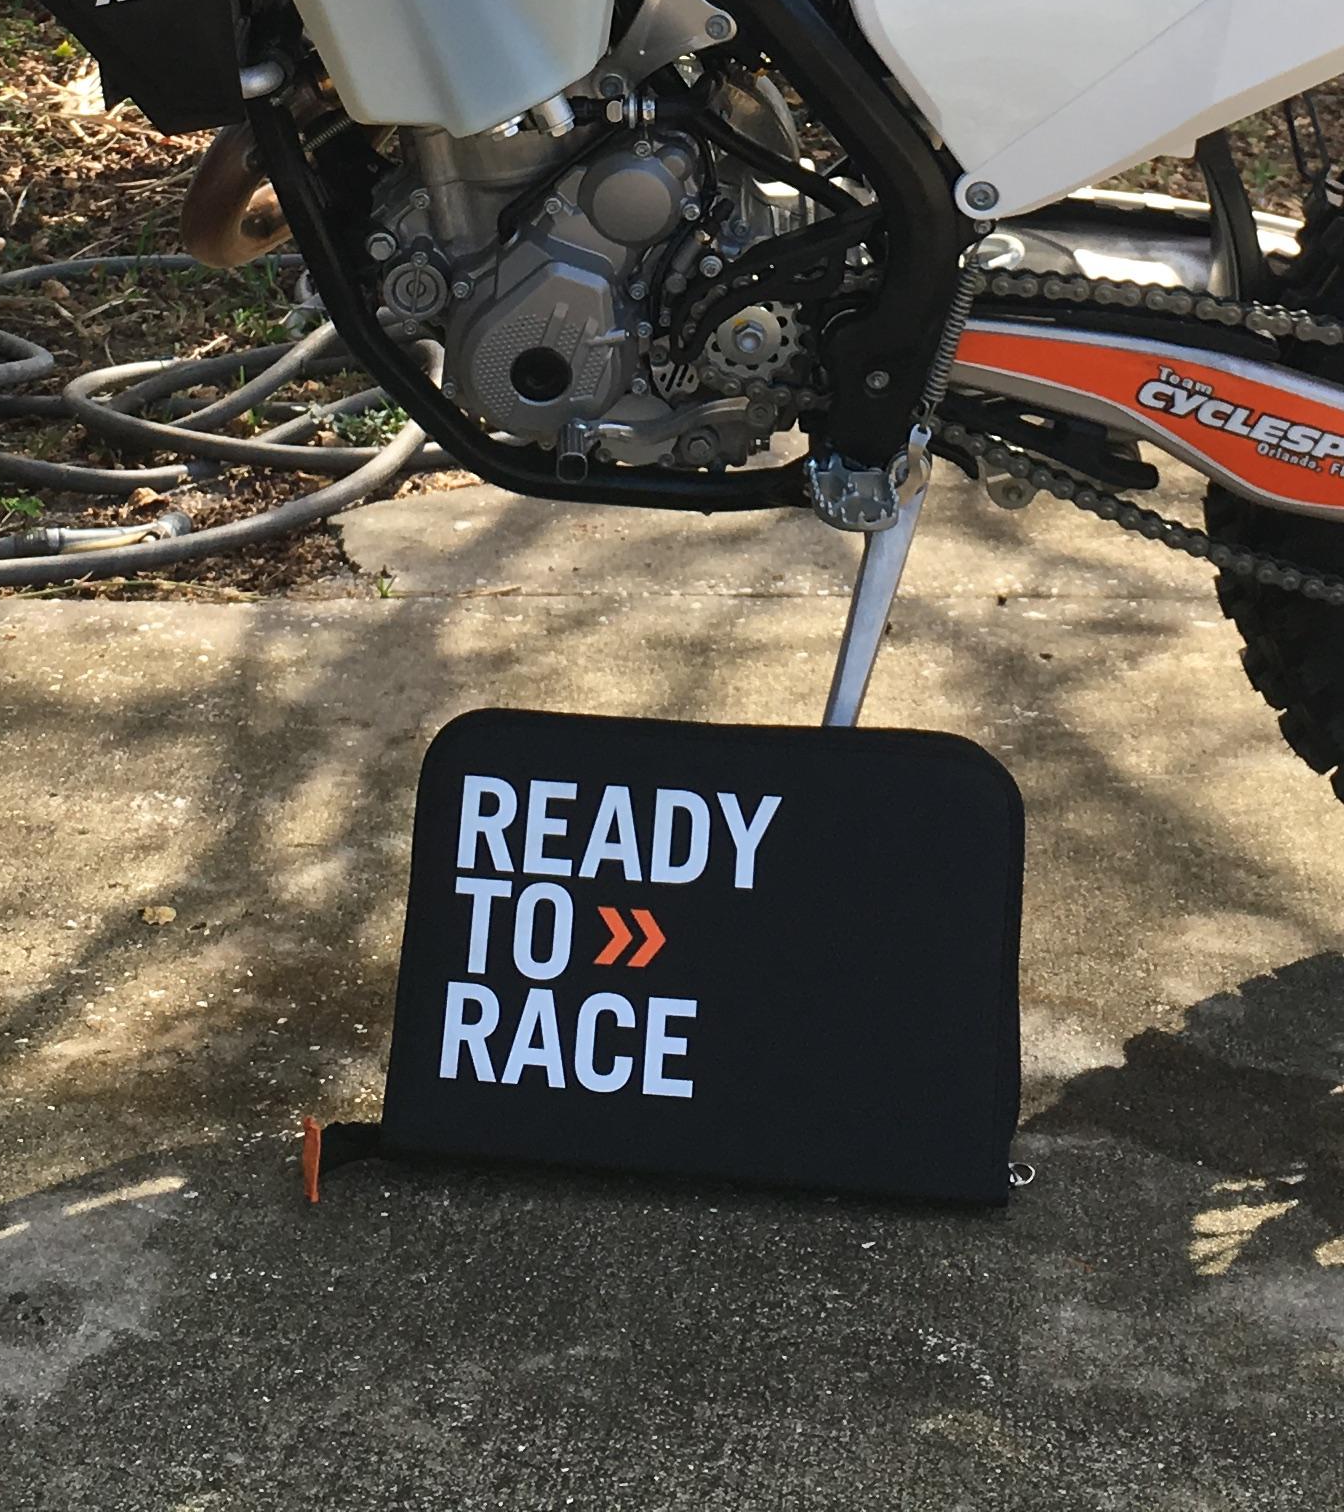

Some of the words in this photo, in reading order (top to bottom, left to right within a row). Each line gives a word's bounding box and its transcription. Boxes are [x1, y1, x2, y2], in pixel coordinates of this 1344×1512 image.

[1159, 366, 1213, 395] Team
[456, 775, 783, 889] READY
[455, 877, 574, 981] TO
[439, 981, 698, 1099] RACE
